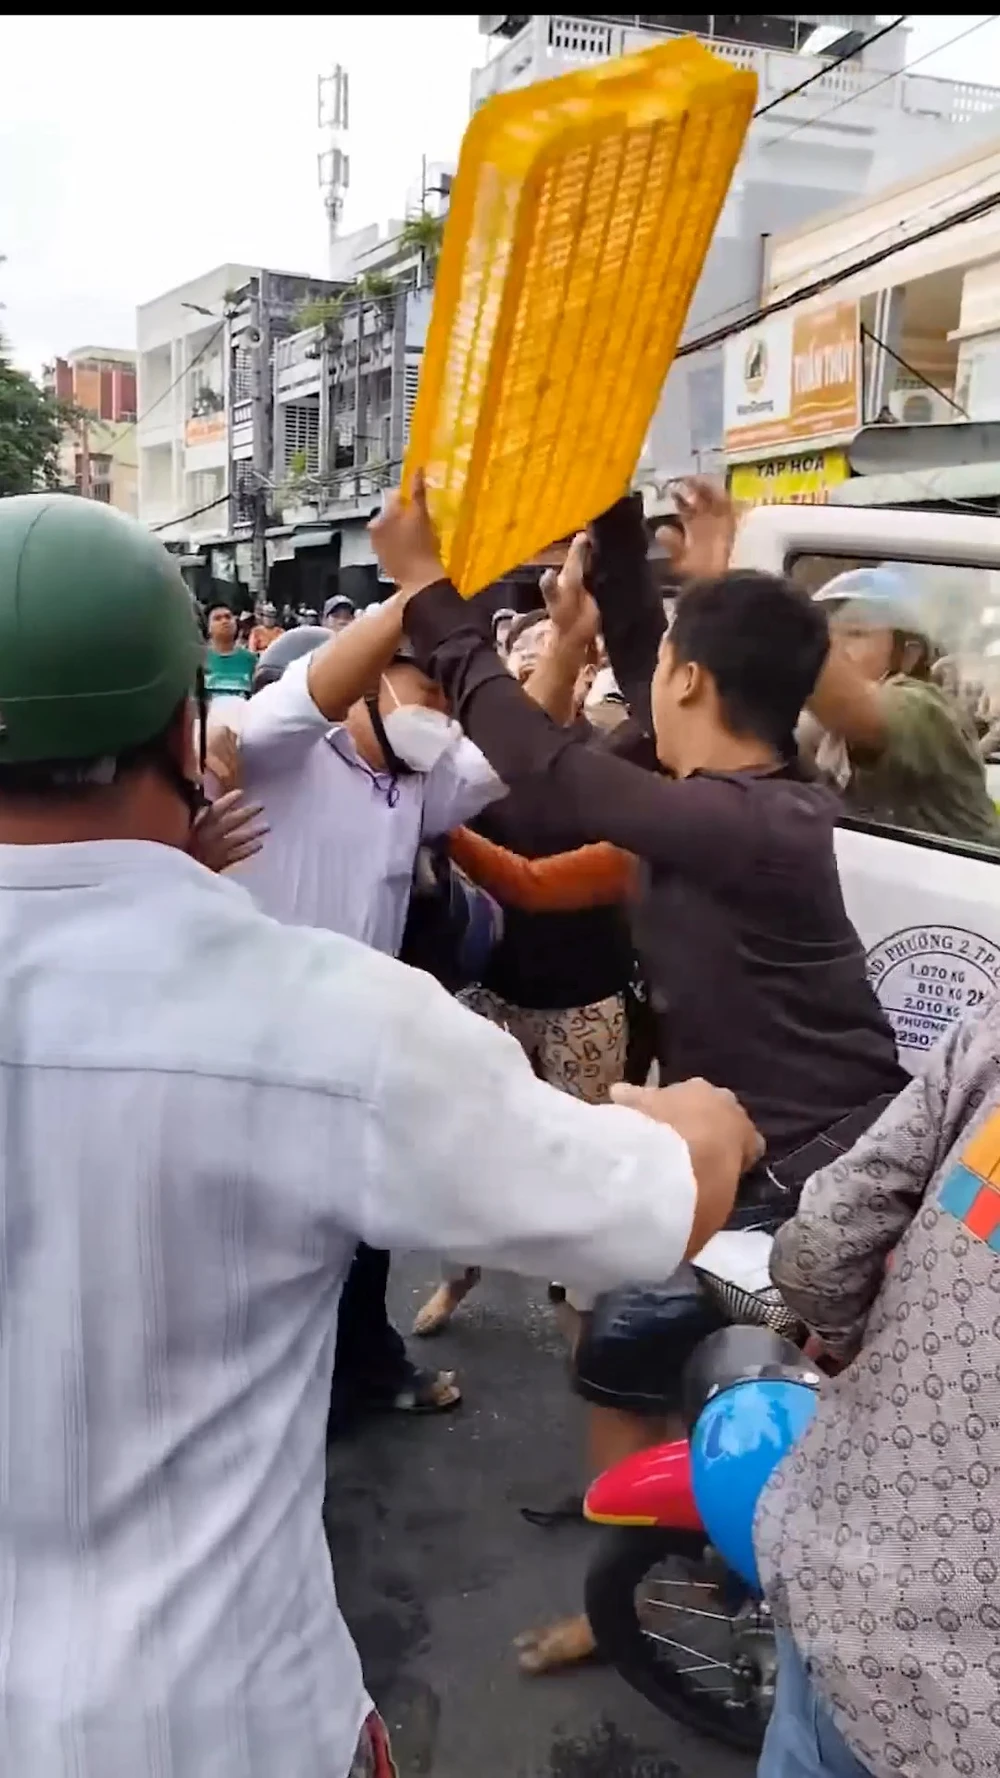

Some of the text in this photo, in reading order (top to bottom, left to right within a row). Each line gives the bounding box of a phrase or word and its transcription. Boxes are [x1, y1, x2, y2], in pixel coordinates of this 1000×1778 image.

[911, 963, 965, 983] 1.070 KG
[918, 983, 962, 1000] 810 KG
[904, 997, 942, 1013] 2.010
